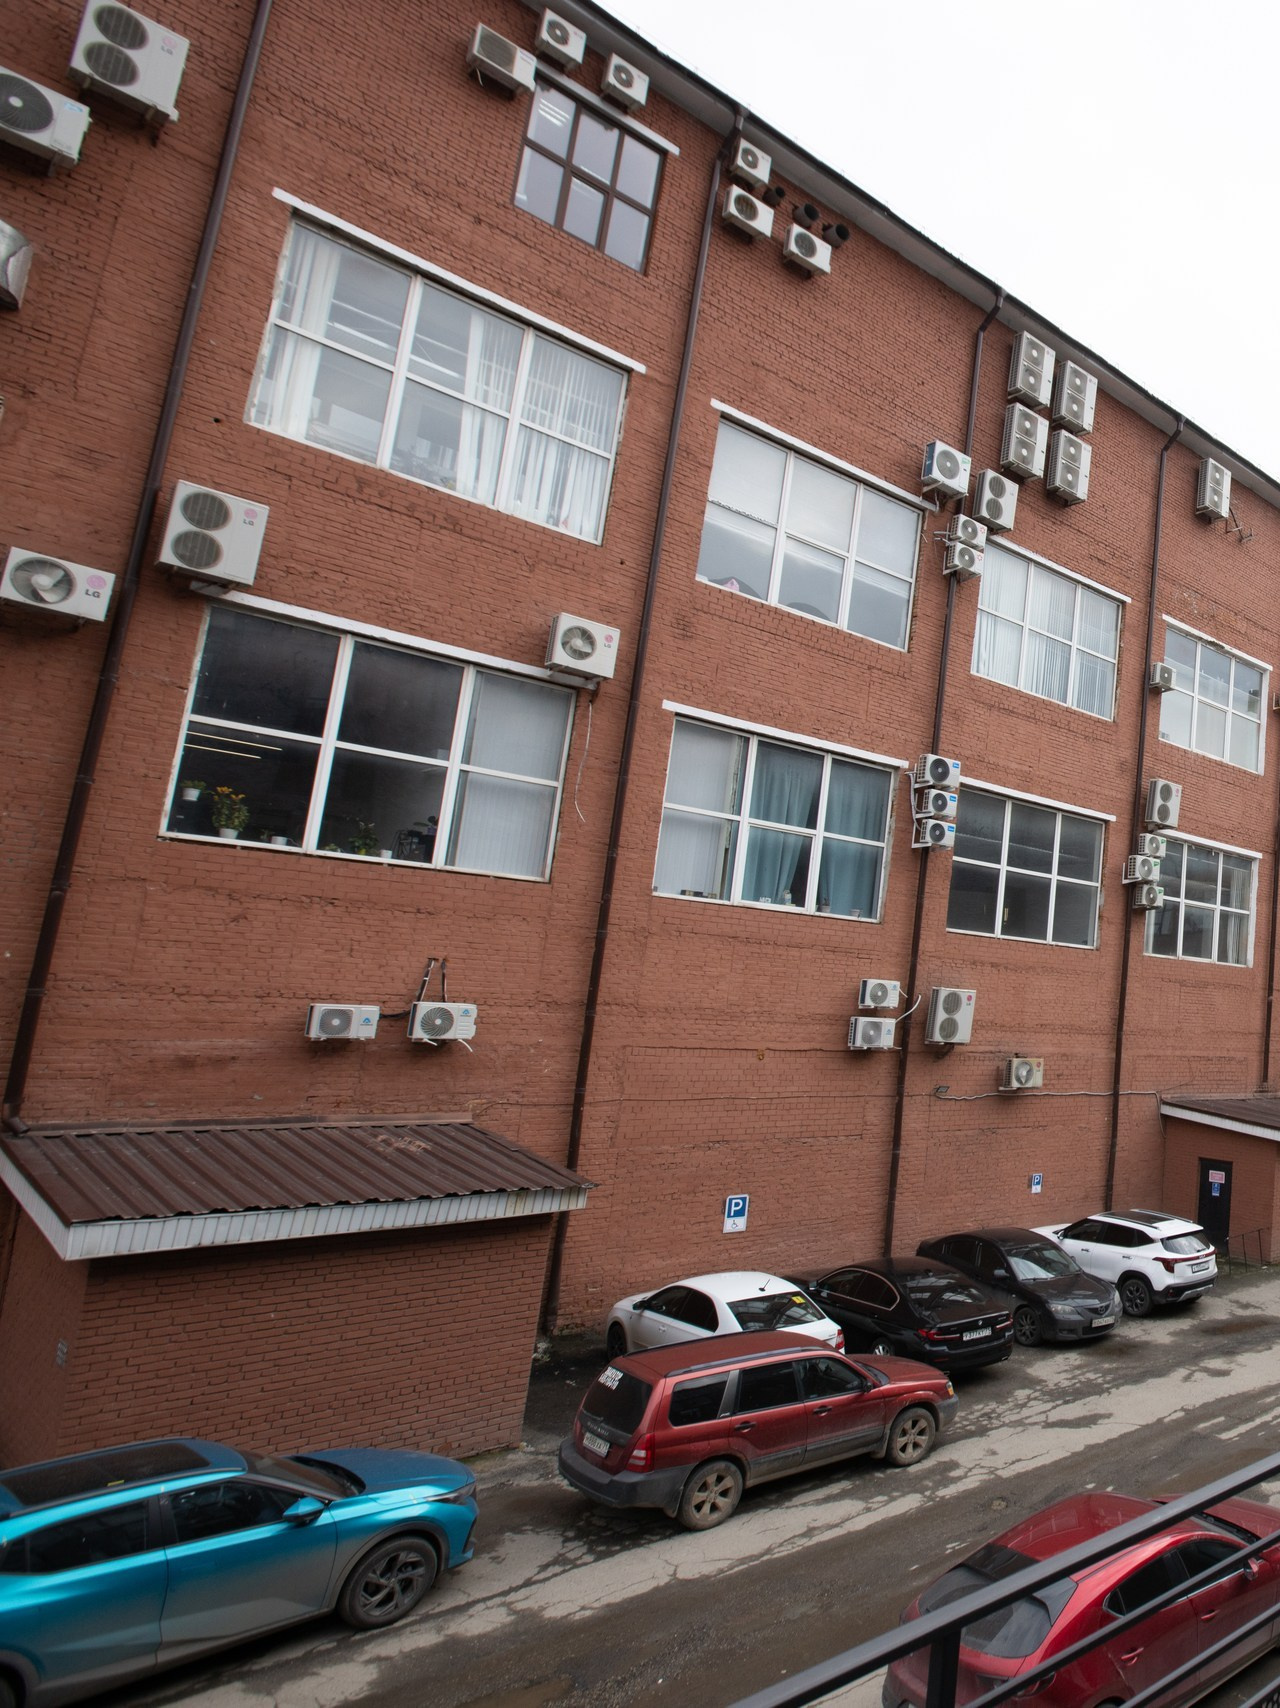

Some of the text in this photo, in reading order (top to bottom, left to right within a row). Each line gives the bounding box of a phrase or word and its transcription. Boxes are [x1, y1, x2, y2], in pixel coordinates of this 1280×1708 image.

[243, 518, 254, 526] LG
[85, 589, 101, 598] LG
[1034, 1175, 1041, 1185] P
[730, 1199, 743, 1216] P
